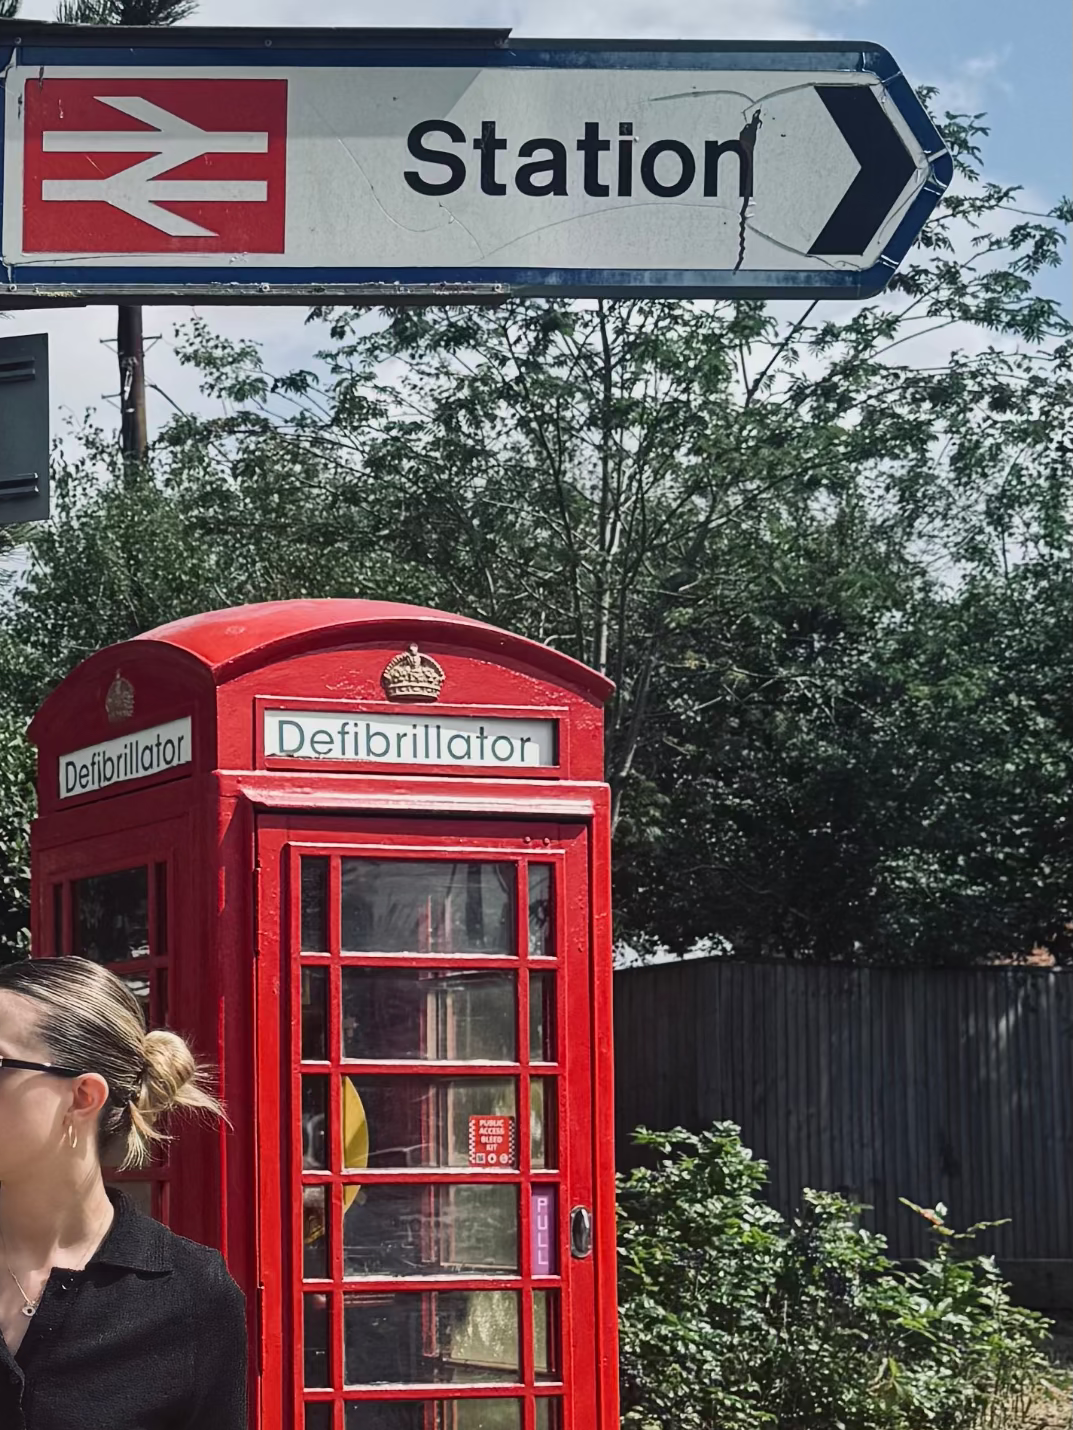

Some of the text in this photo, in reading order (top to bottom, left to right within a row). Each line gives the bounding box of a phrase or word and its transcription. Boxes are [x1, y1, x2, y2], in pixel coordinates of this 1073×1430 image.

[403, 119, 754, 197] Station
[65, 734, 184, 793] Defibrillator
[278, 720, 531, 763] Defibrillator
[479, 1127, 505, 1135] ACCESS
[538, 1197, 548, 1265] PULL
